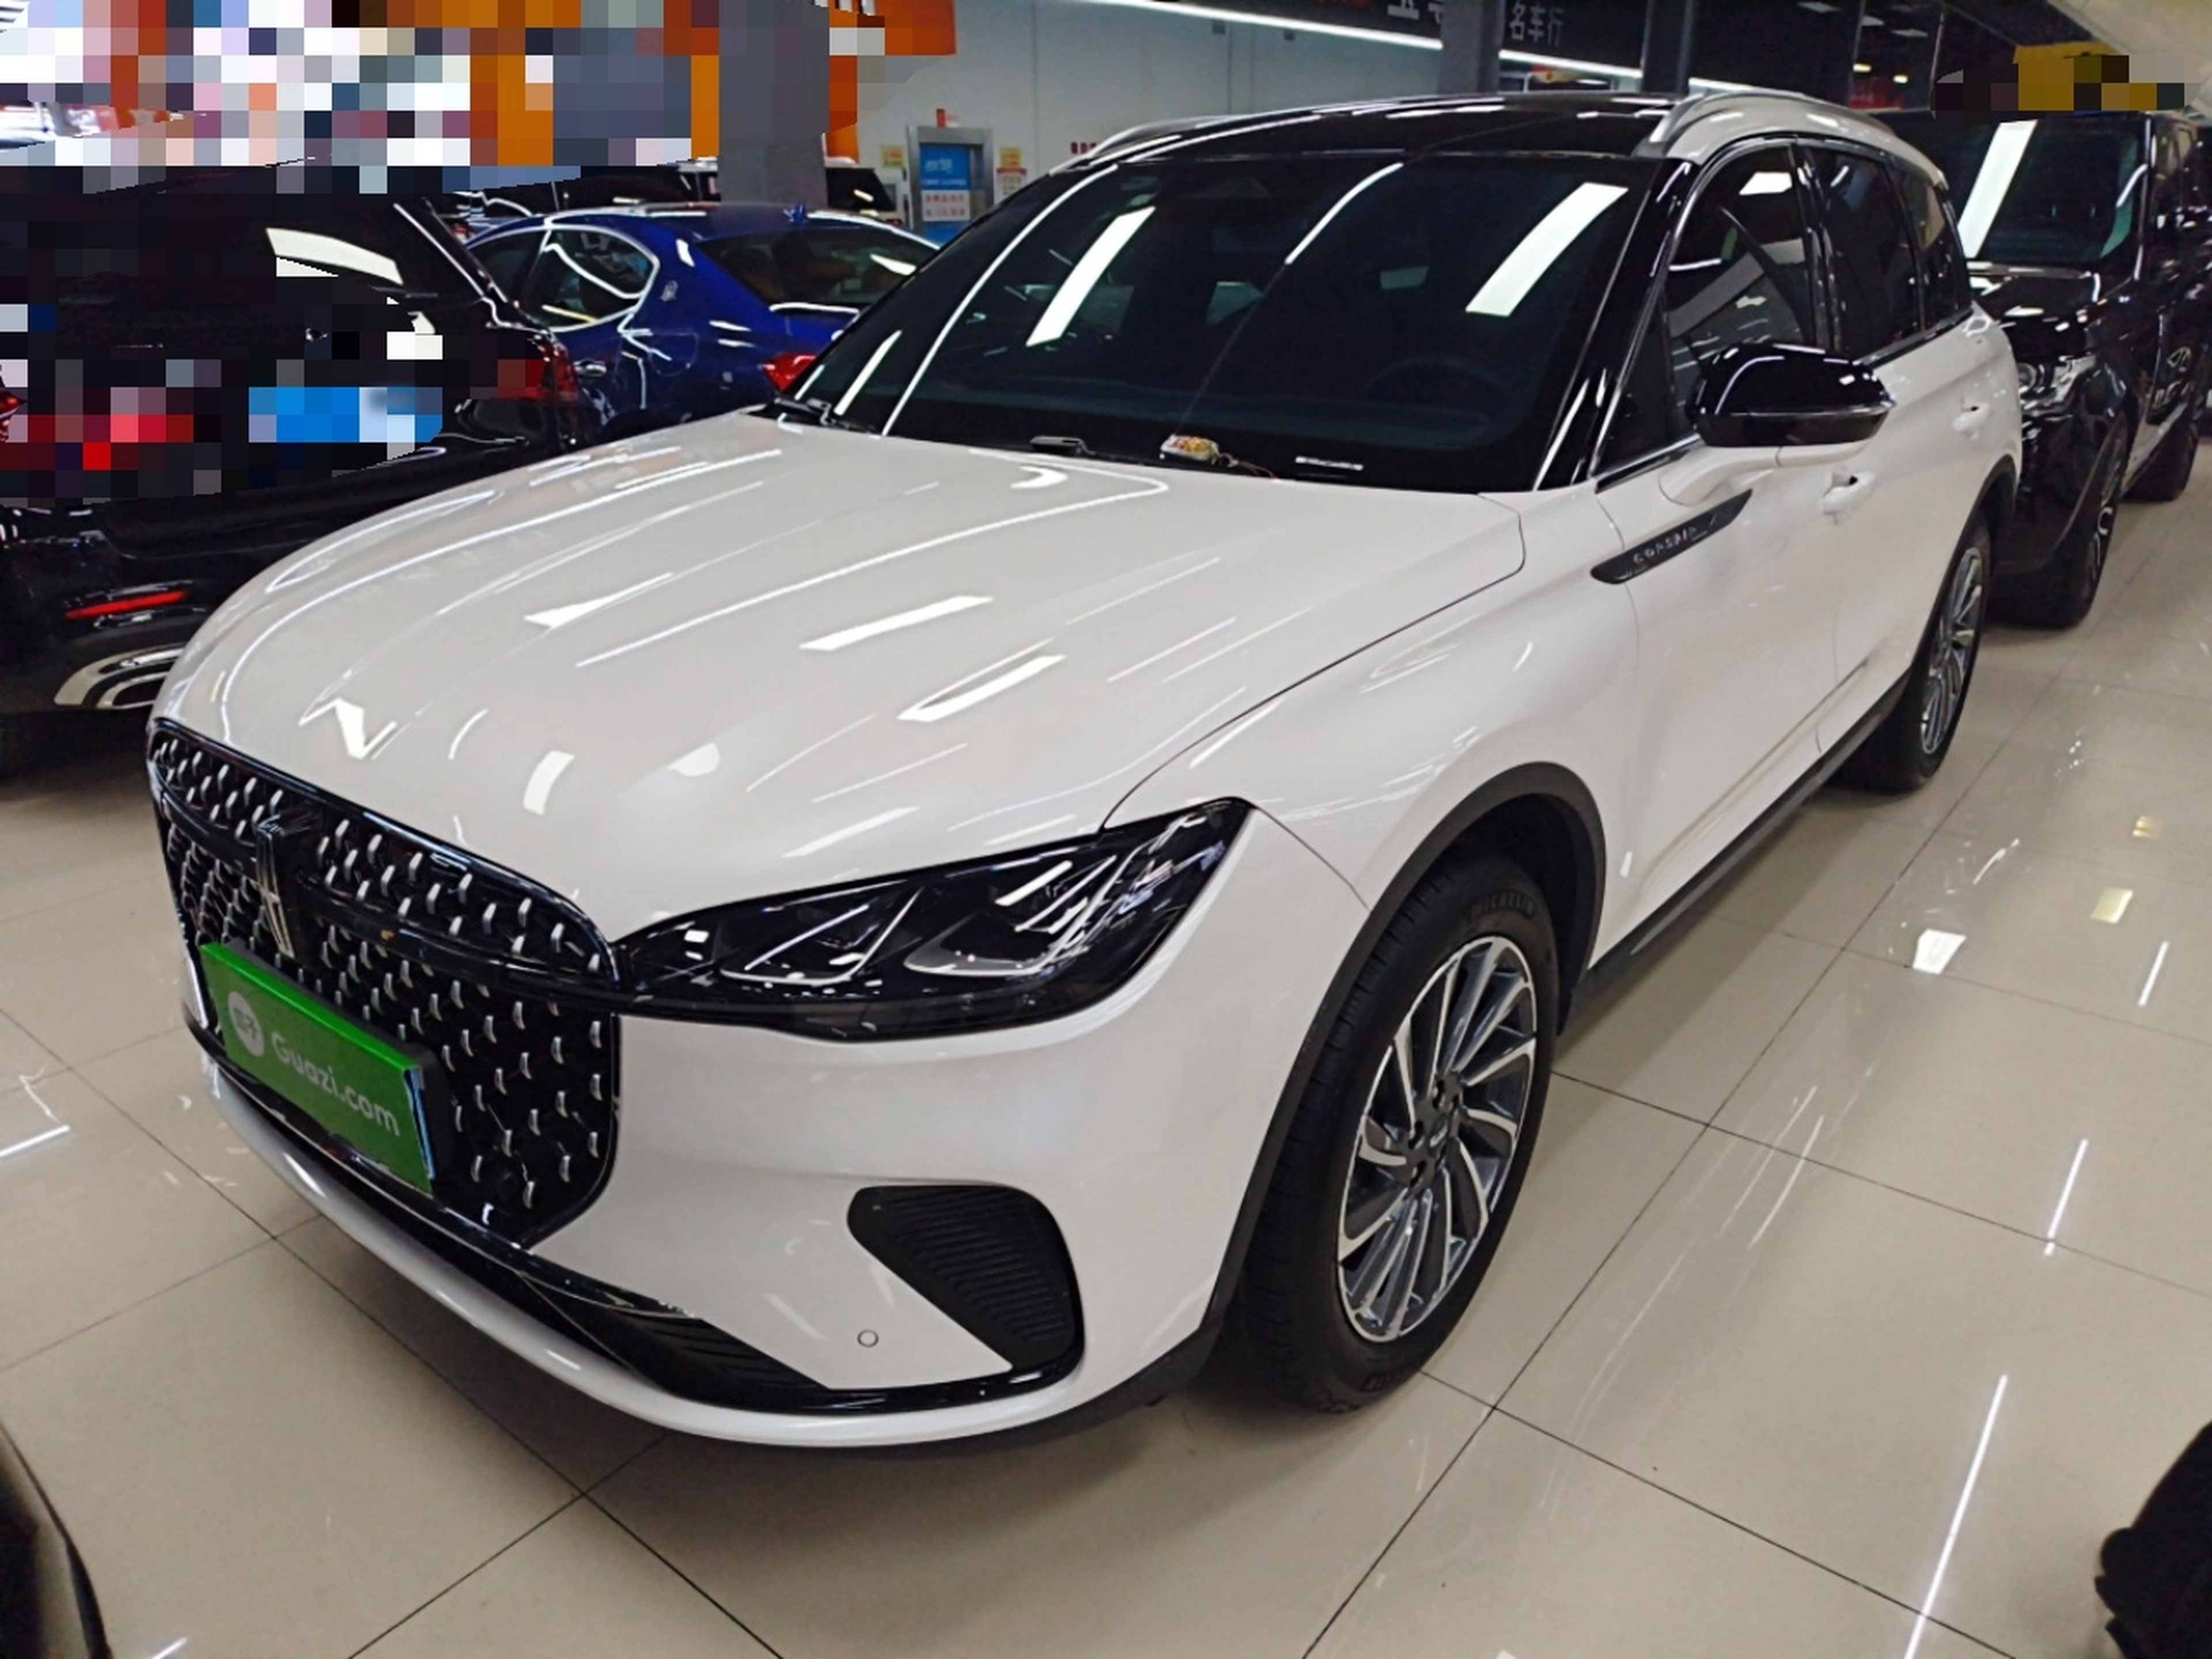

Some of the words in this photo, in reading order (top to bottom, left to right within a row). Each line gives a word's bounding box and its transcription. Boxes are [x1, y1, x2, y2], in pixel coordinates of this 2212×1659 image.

[1509, 1, 1563, 46] 名车行
[271, 1031, 401, 1137] Guazi.com
